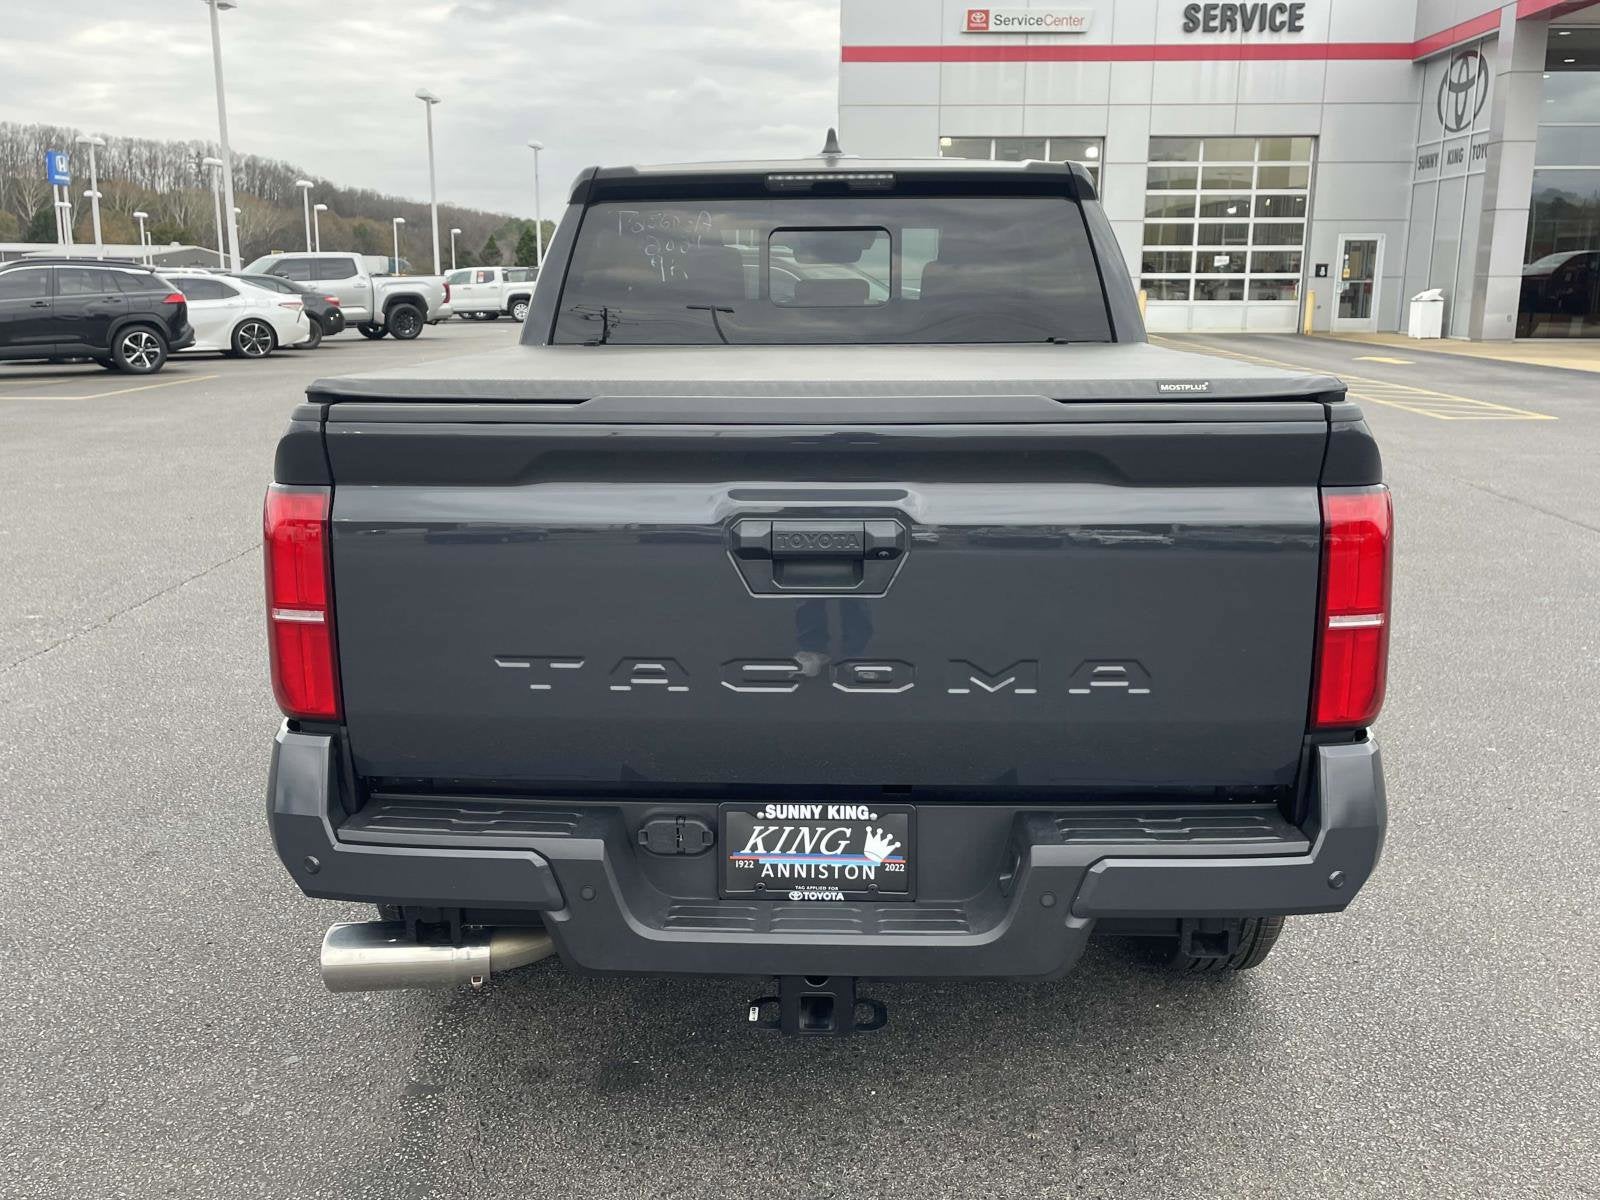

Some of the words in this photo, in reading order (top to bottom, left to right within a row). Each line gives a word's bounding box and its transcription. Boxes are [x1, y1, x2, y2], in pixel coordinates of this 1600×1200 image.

[1183, 3, 1305, 33] SERVICE
[1418, 153, 1439, 170] SUNNY
[1447, 147, 1464, 165] KING
[1160, 383, 1208, 391] MOSTPLUS
[776, 532, 860, 549] TOYOTA
[494, 654, 1153, 695] TACOMA
[765, 804, 822, 819] SUNNY
[827, 805, 869, 820] KING
[739, 825, 852, 855] KING
[735, 860, 754, 869] 1922
[761, 864, 875, 880] ANNISTON
[885, 863, 905, 872] 2022
[803, 891, 844, 900] TOYOTA
